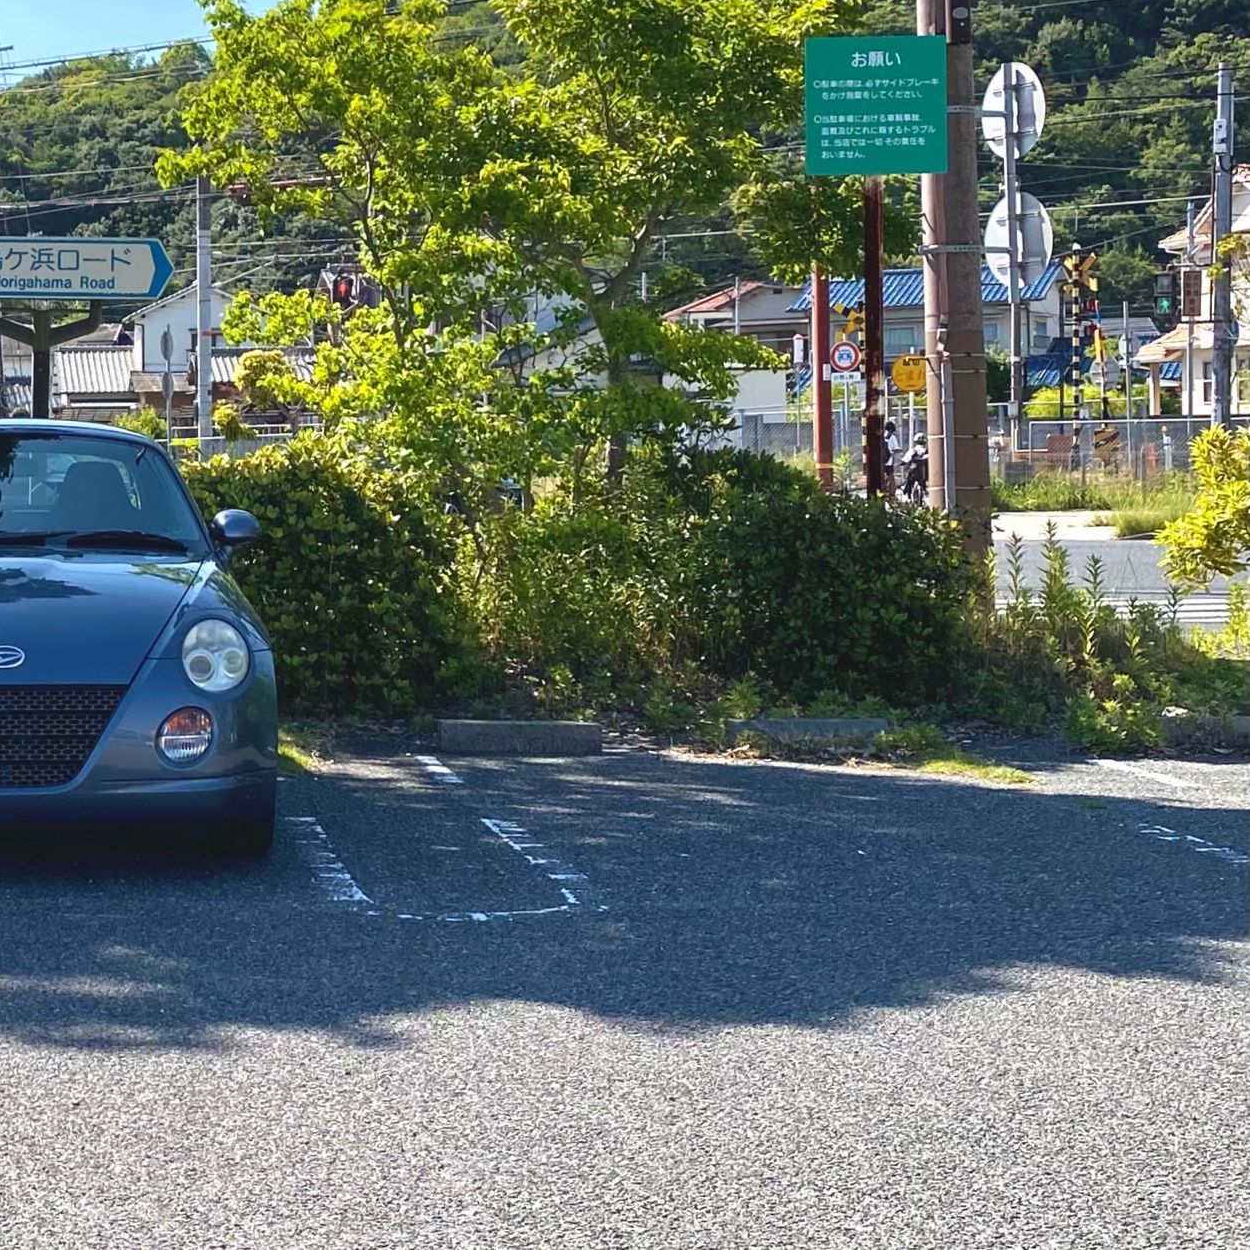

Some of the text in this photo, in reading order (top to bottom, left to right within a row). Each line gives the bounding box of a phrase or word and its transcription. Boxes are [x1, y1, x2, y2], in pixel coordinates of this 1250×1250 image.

[851, 51, 901, 67] お願い
[80, 276, 115, 289] Road
